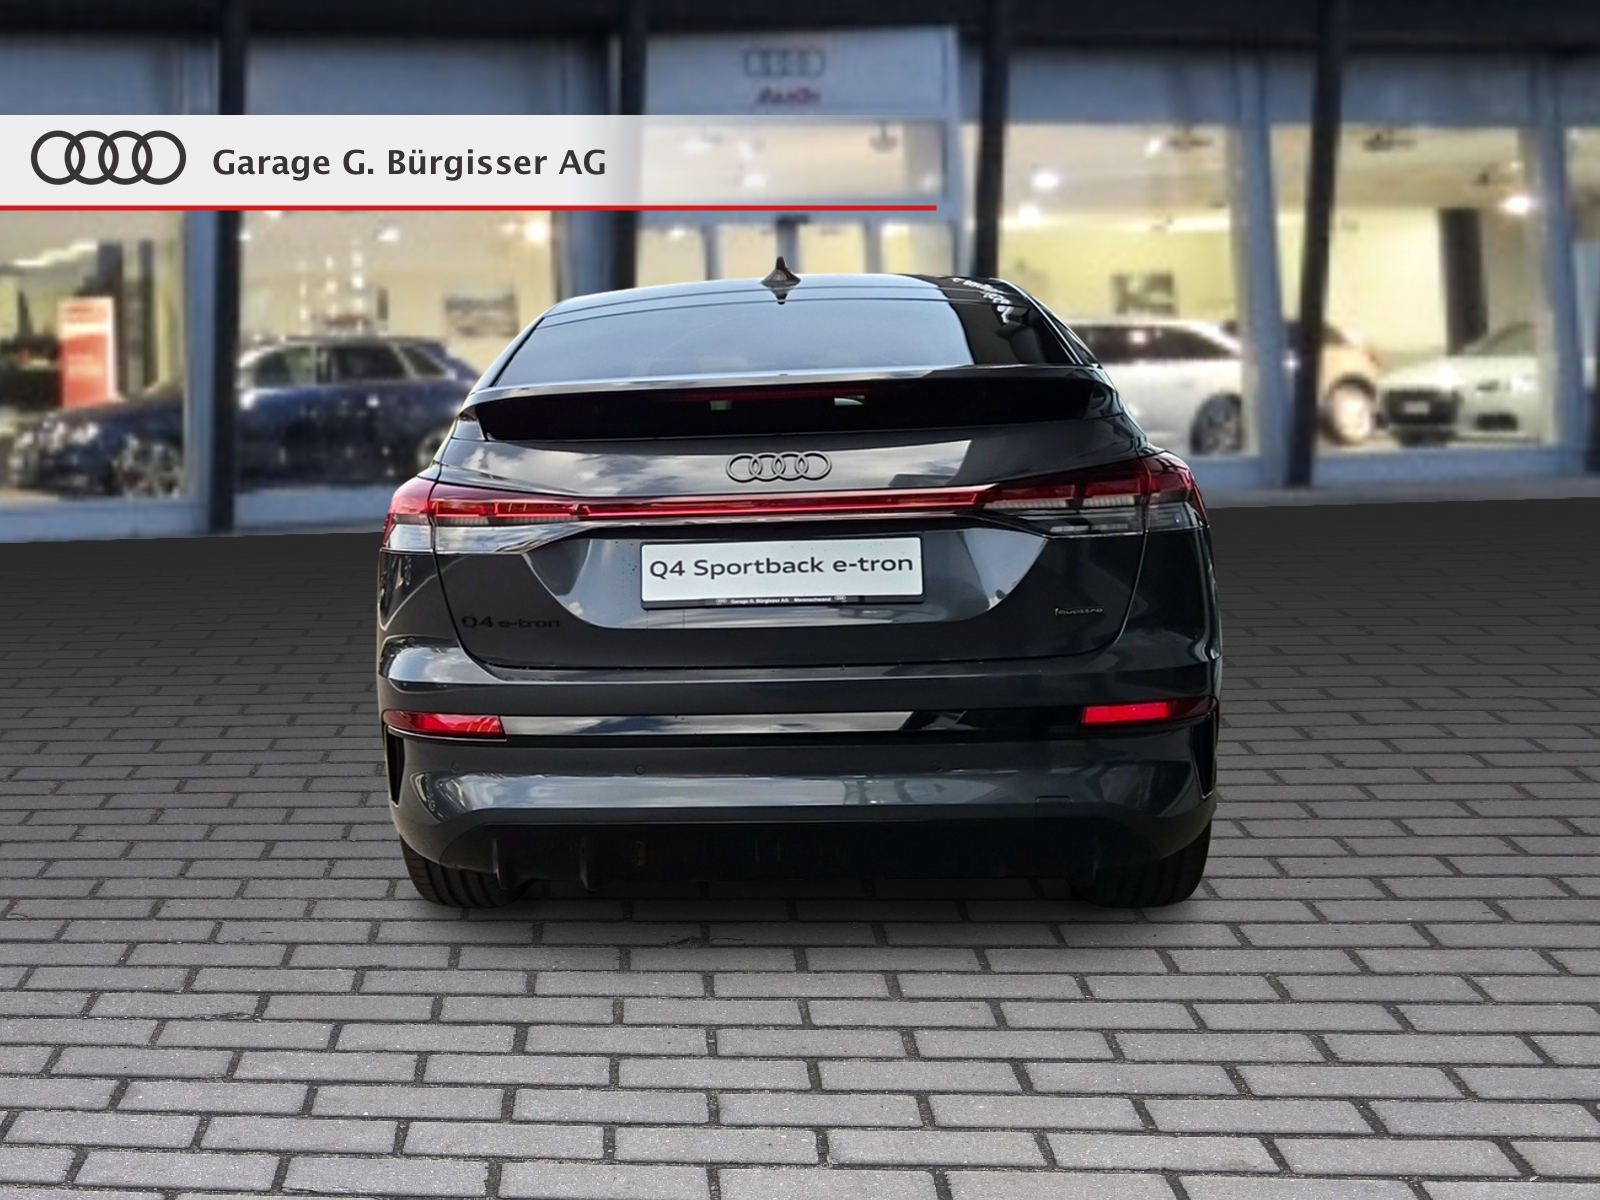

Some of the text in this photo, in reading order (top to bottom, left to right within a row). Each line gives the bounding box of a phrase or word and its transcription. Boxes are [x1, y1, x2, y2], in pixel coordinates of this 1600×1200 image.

[649, 556, 914, 580] Q4 Sportback e-tron
